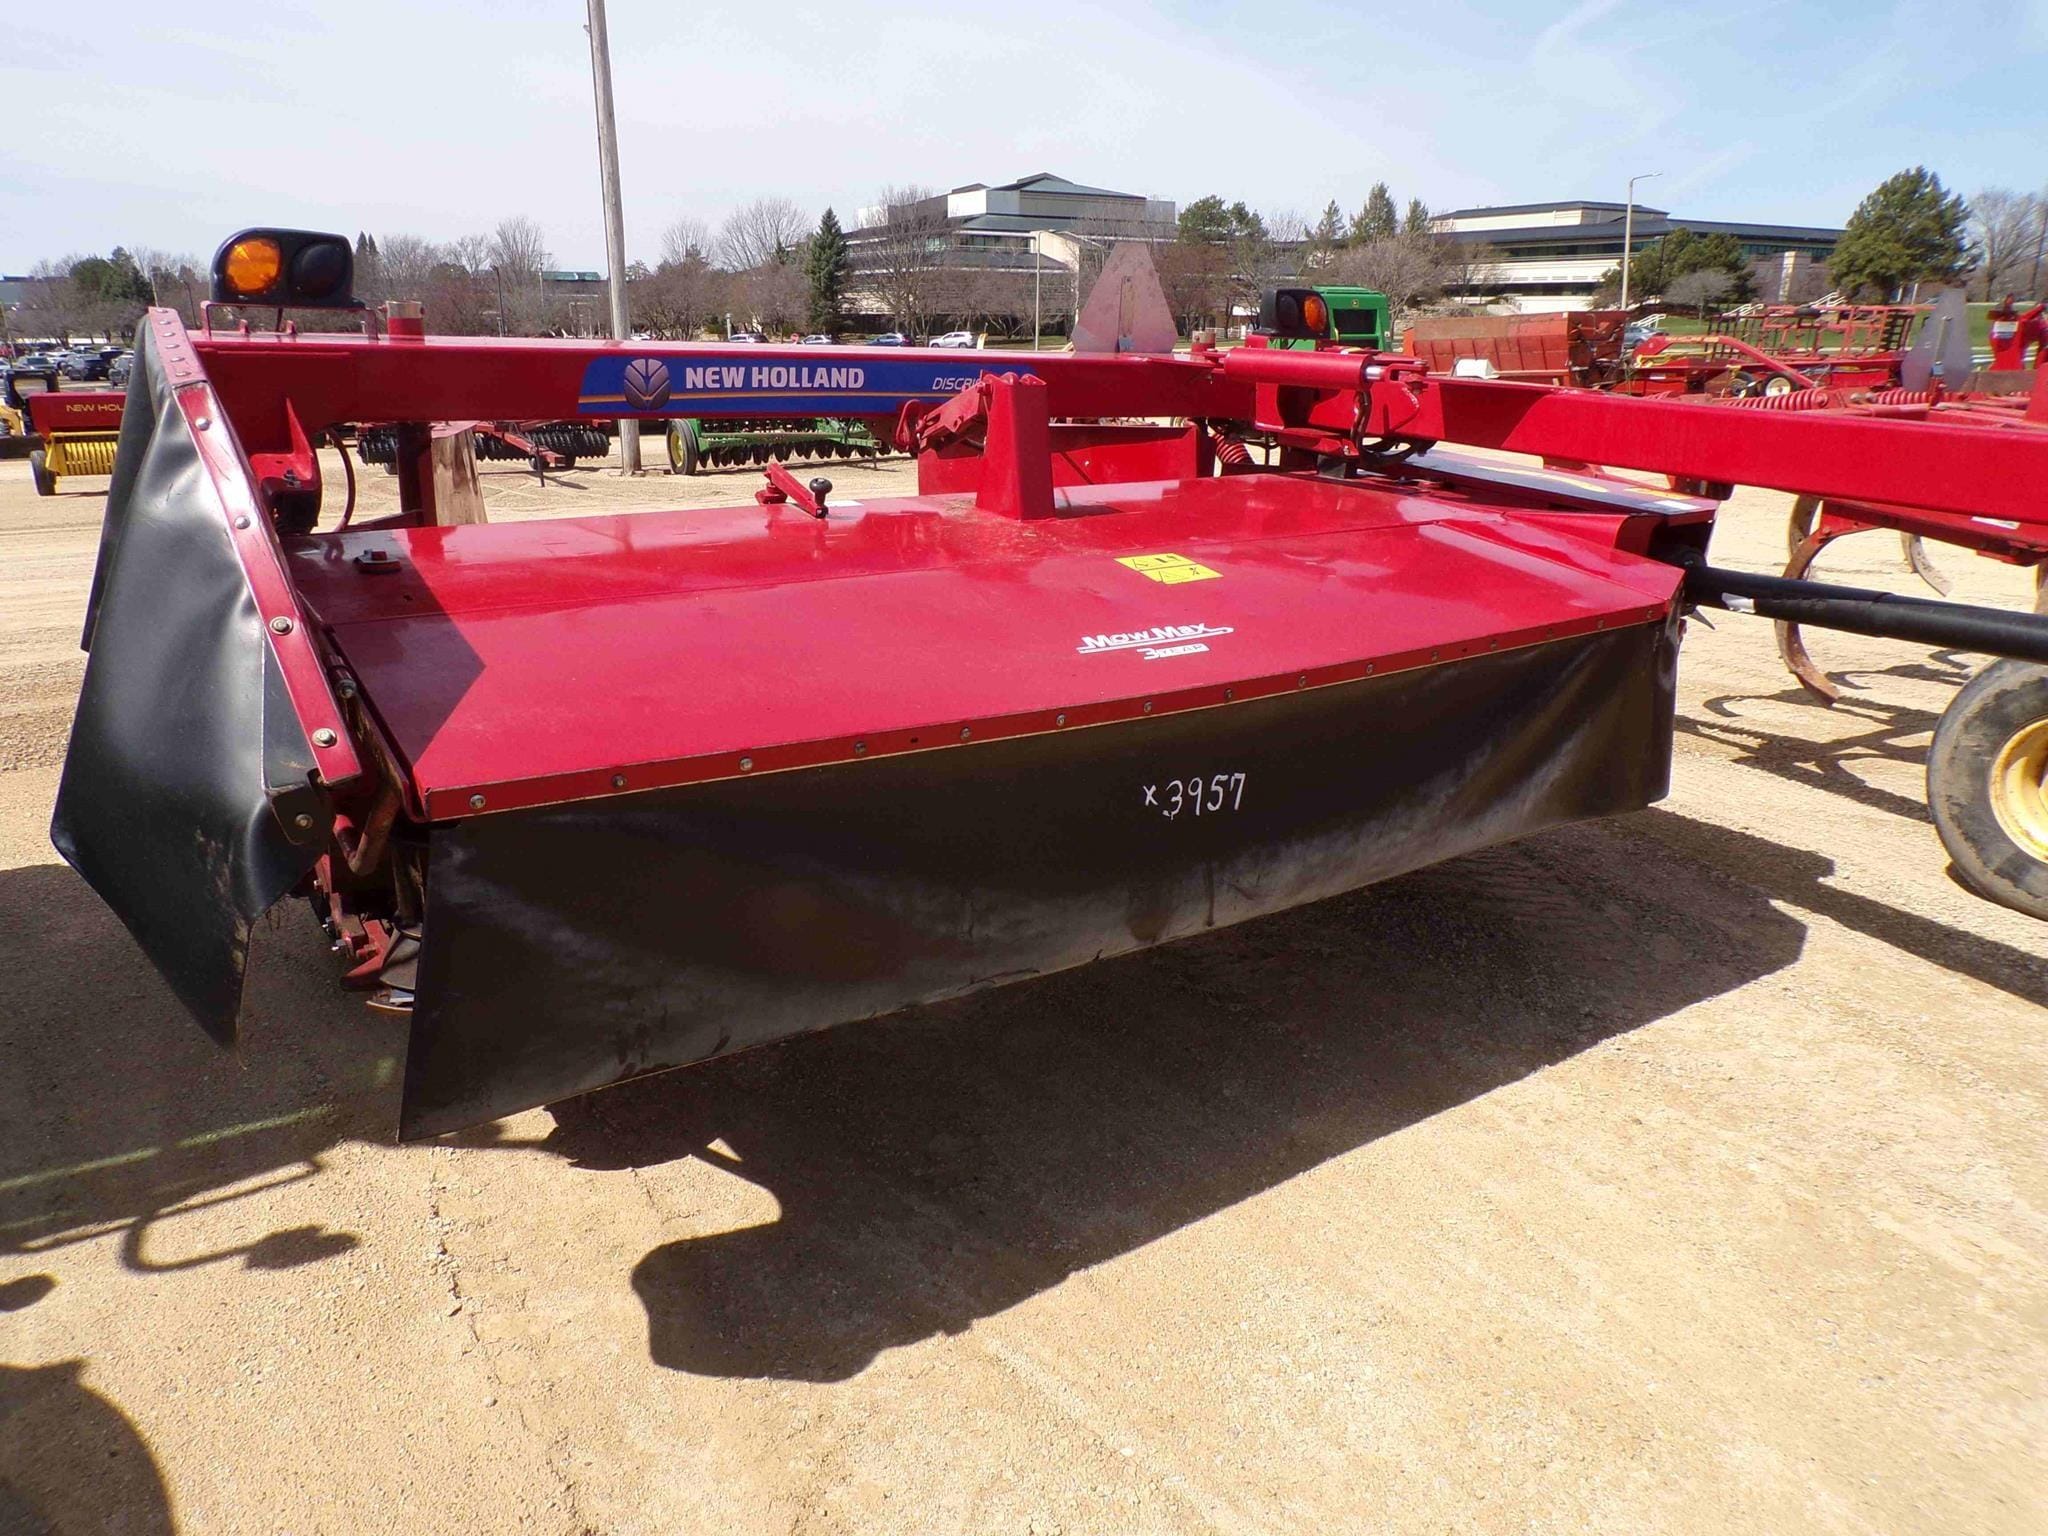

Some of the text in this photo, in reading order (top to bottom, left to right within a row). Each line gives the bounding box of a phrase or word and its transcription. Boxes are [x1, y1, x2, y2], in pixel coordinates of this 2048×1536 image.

[685, 366, 866, 389] NEW HOLLAND
[65, 404, 95, 412] NEW
